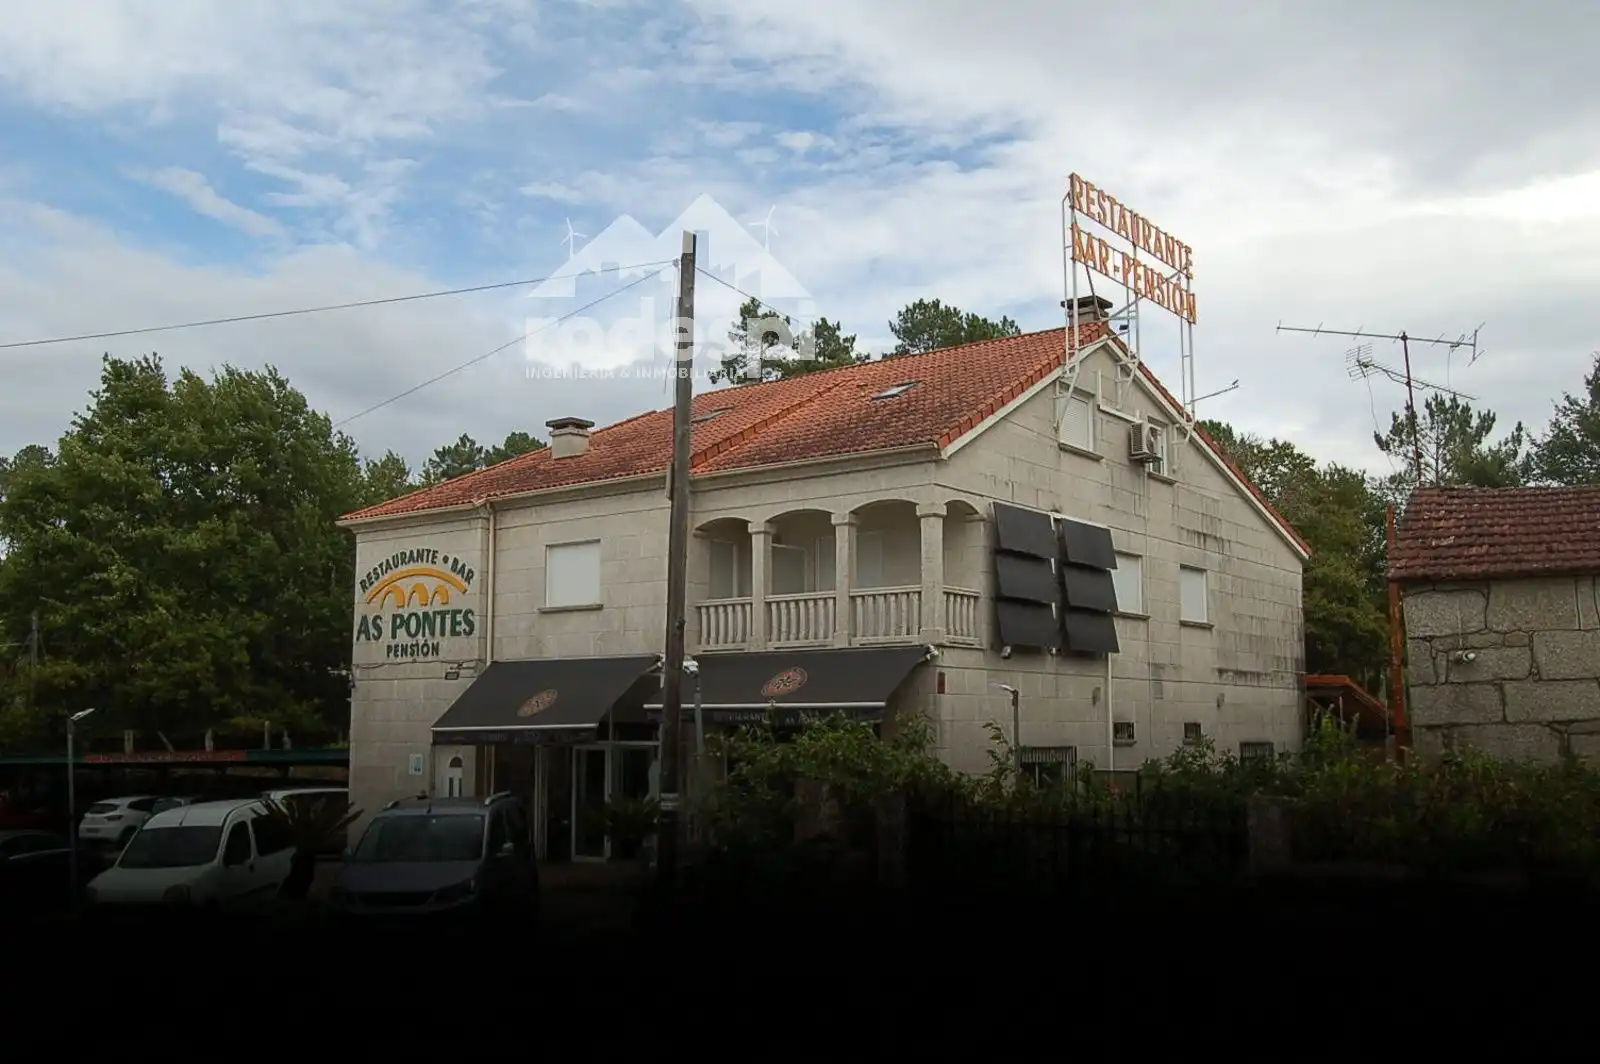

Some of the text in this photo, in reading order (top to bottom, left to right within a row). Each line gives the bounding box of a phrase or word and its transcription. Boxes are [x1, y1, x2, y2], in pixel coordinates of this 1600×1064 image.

[1069, 173, 1193, 280] RESTAURANTE
[359, 548, 474, 593] RESTAURANTE BAR
[356, 608, 475, 641] AS PONTES
[386, 639, 440, 659] PENSIÓN
